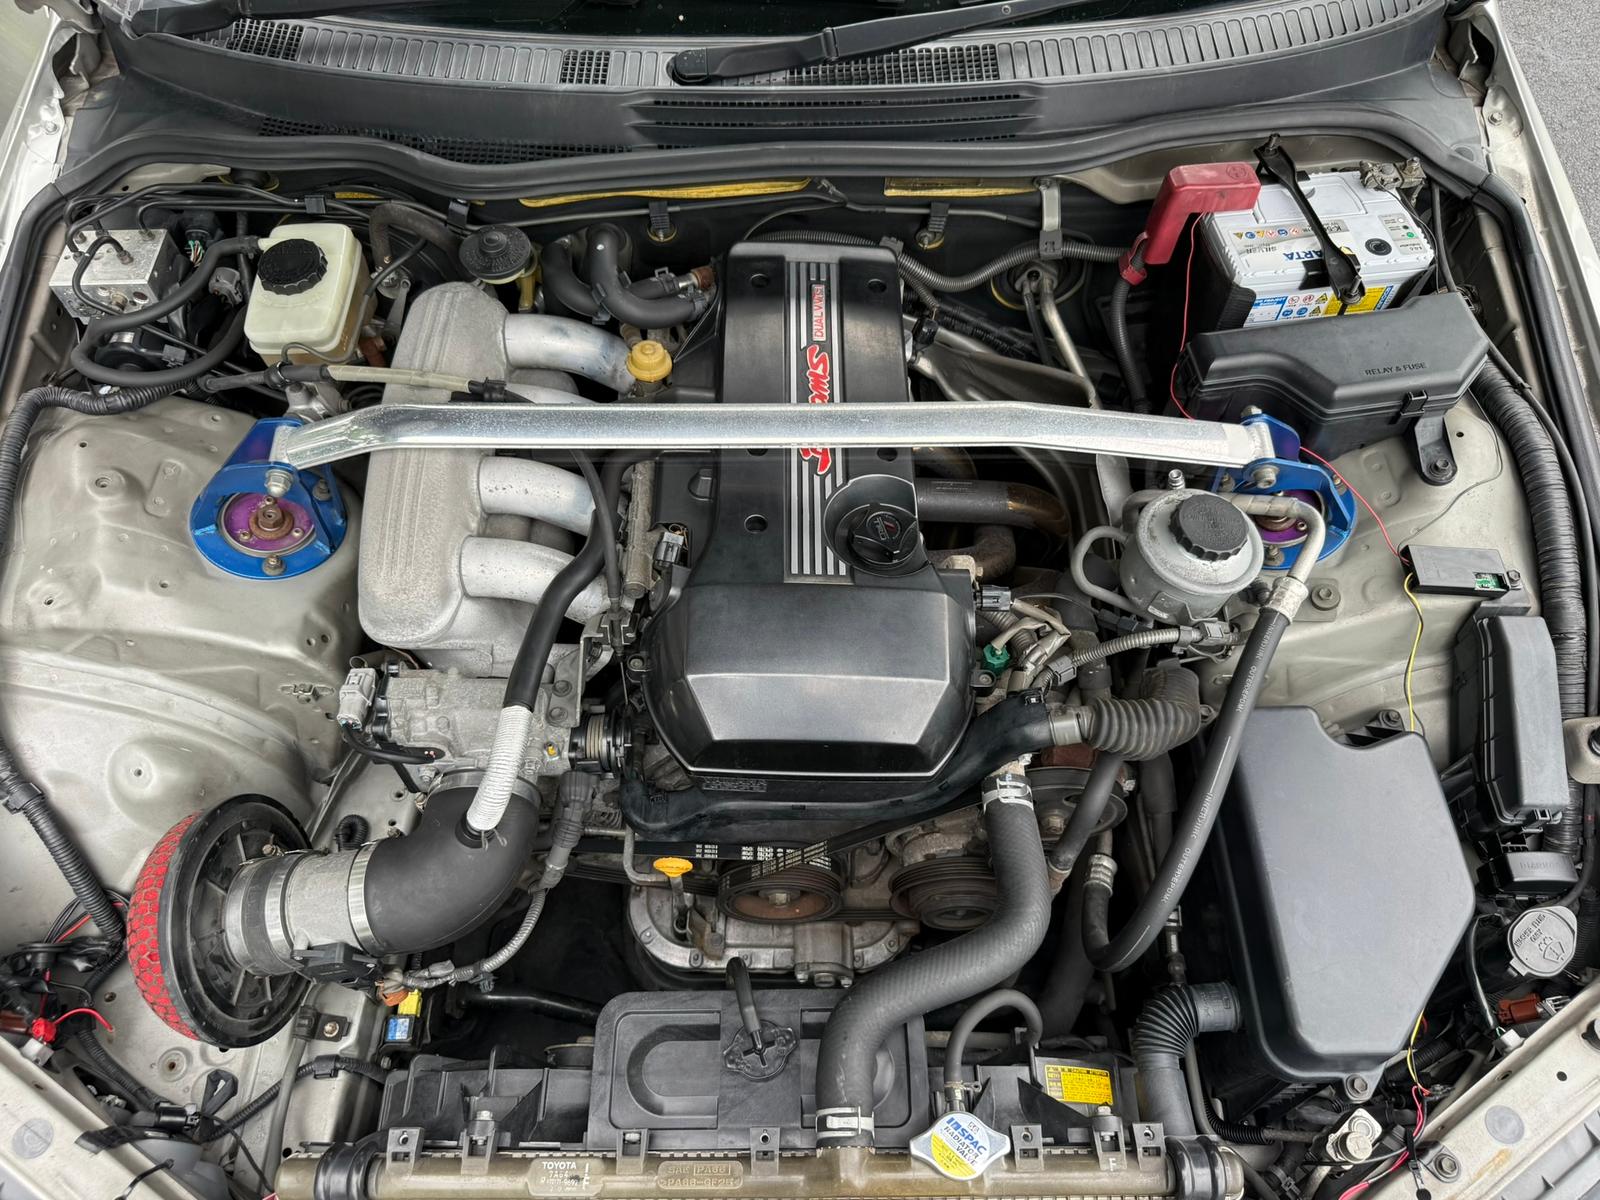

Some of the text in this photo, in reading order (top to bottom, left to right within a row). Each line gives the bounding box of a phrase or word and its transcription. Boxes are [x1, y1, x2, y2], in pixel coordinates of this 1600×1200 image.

[1283, 250, 1324, 260] ARTA
[814, 312, 825, 338] DUAL
[1364, 366, 1393, 375] RELAY
[1403, 362, 1427, 370] FUSE
[944, 1126, 979, 1159] RADIATOR
[542, 1161, 577, 1170] TOYOTA
